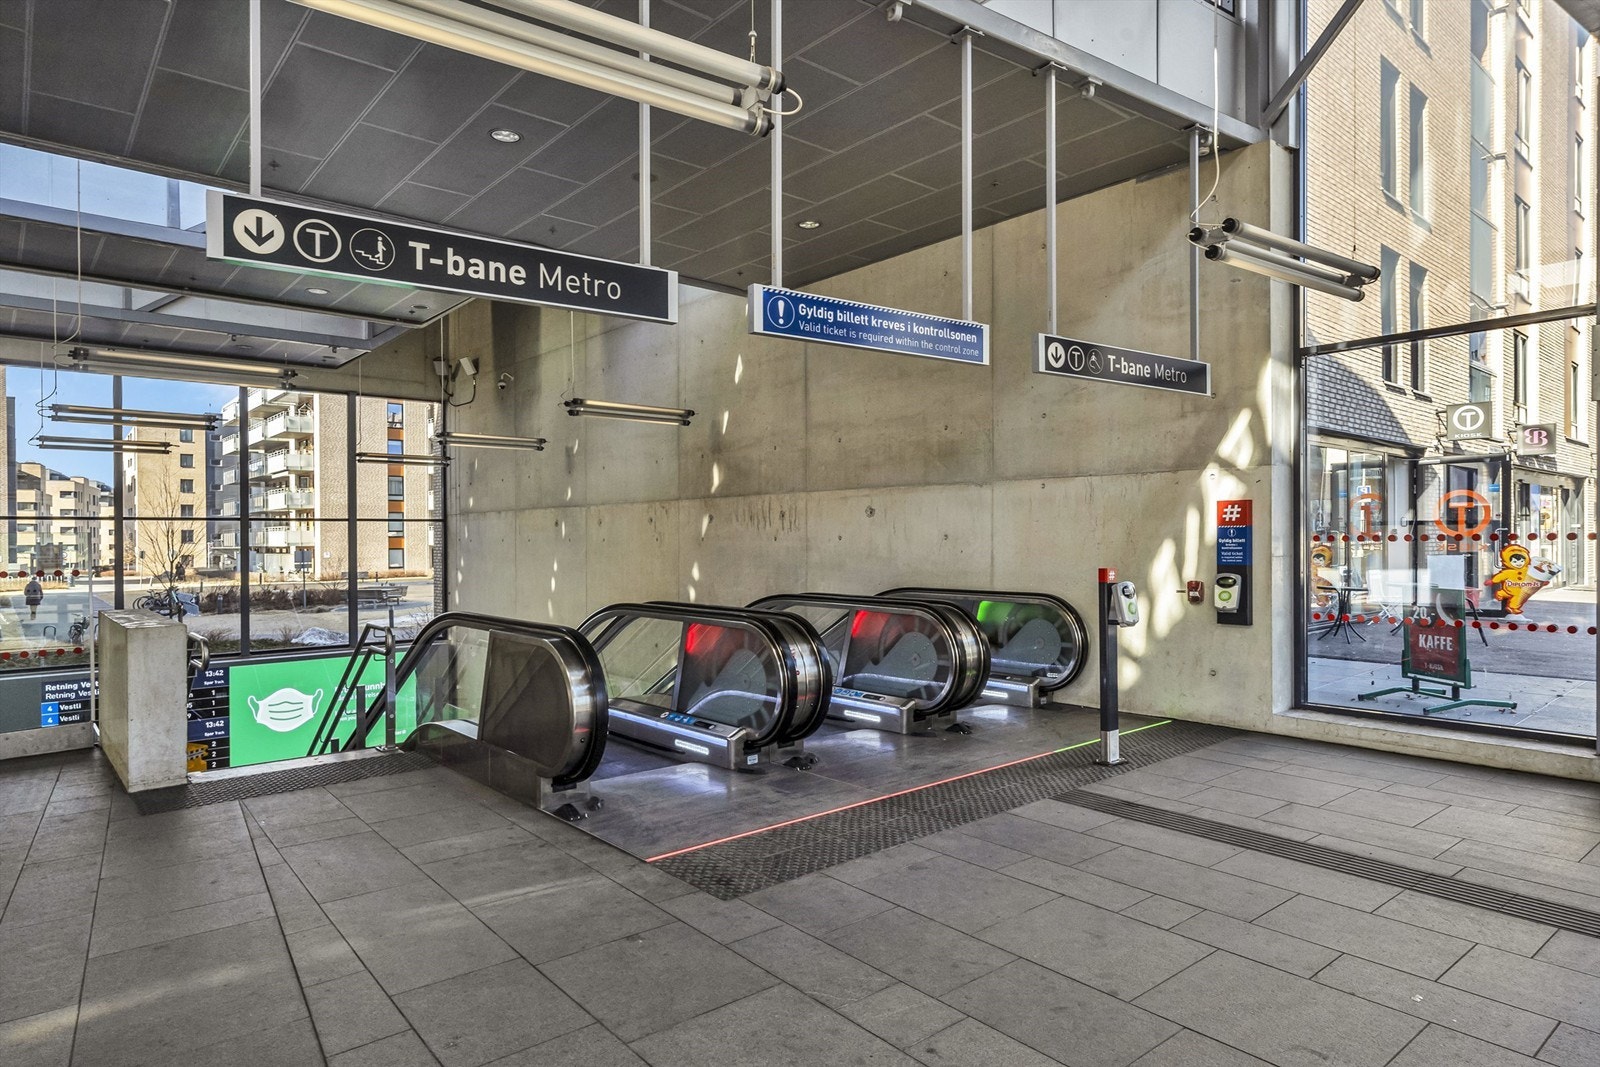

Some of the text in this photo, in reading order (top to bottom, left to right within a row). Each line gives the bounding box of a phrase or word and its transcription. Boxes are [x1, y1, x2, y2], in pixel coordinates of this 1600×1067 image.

[408, 241, 527, 286] T-bane
[539, 262, 622, 300] Metro
[798, 303, 978, 343] Gyldig billett kreves i kontrollsonen
[798, 320, 979, 357] Valid ticket is required within the control zone
[1107, 354, 1151, 378] T-bane
[1154, 363, 1187, 384] Metro
[1418, 633, 1453, 651] KAFFE
[205, 669, 224, 677] 13:42
[45, 683, 78, 691] Retning
[45, 691, 76, 700] Retning
[59, 703, 82, 711] Vestli
[59, 714, 80, 722] Vestli
[205, 720, 225, 728] 13:42
